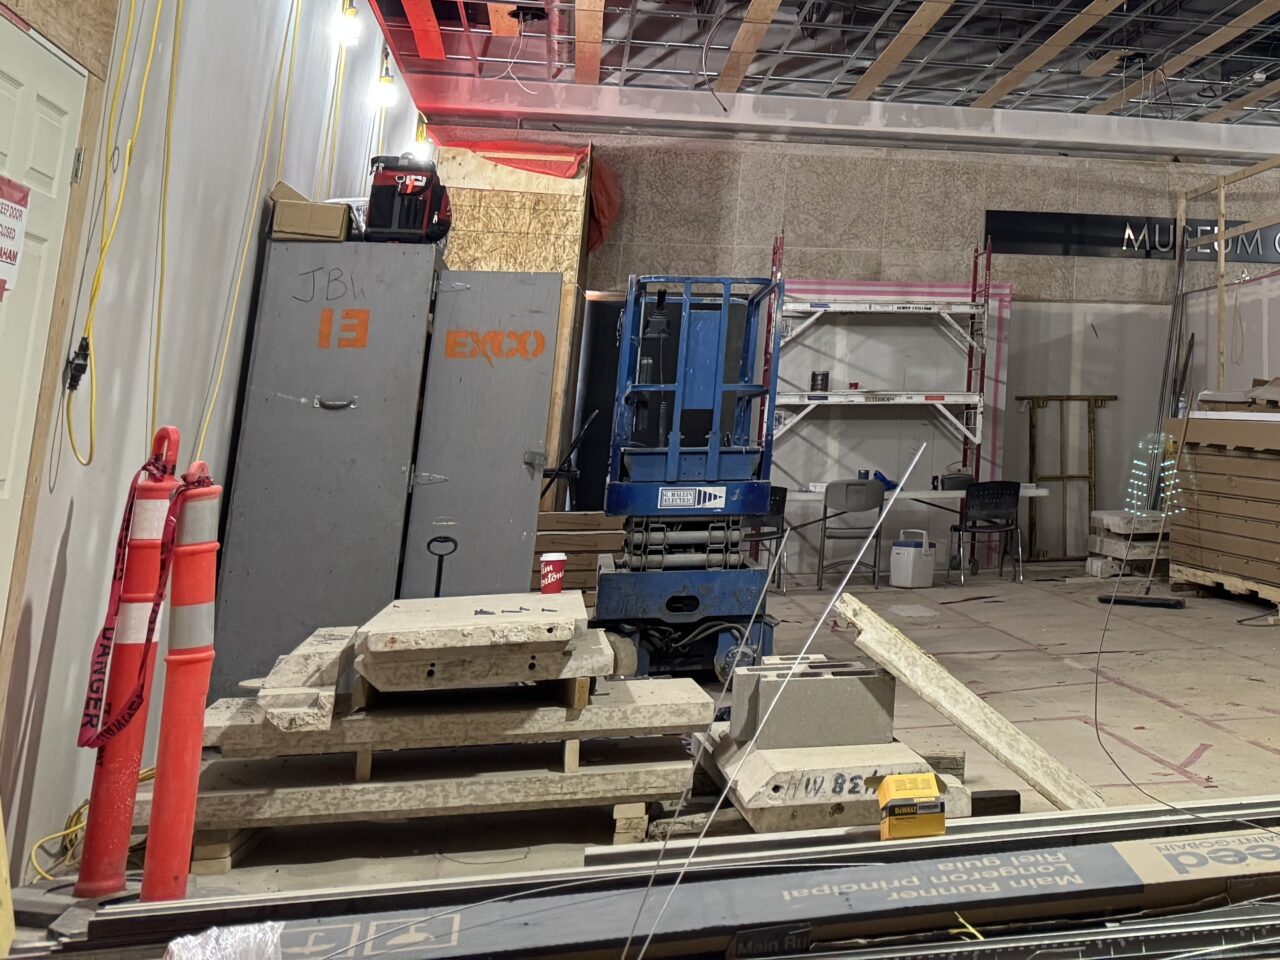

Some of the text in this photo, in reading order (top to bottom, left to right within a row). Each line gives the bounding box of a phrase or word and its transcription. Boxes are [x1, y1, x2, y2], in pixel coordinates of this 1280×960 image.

[9, 206, 23, 221] DOOR
[317, 308, 370, 349] 13
[445, 329, 546, 368] EXCO
[1020, 851, 1067, 864] Riel
[782, 862, 1076, 903] Longeron principal
[887, 874, 1084, 901] Main Runner
